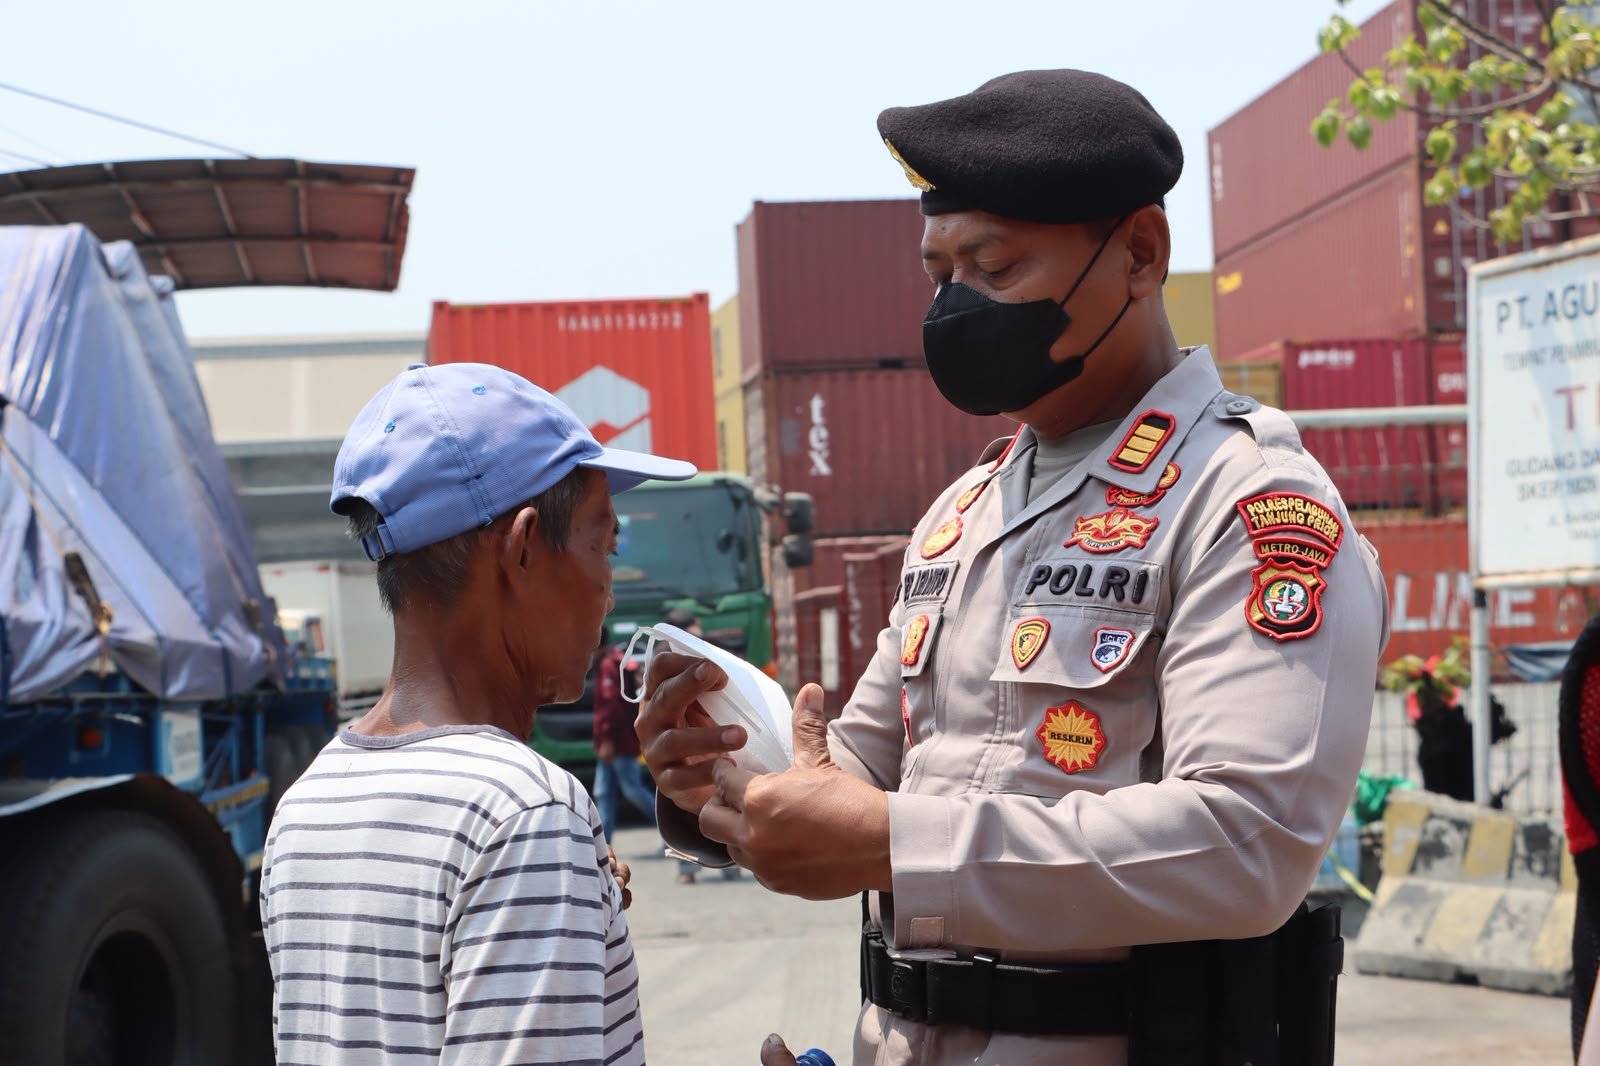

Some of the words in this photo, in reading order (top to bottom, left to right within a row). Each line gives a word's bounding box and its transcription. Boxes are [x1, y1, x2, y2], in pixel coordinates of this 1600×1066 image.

[1497, 296, 1534, 334] PT.
[808, 393, 832, 475] tex
[1251, 510, 1305, 529] TANJUNG
[1307, 516, 1338, 541] PRIOK
[1260, 543, 1300, 554] METRO
[1301, 547, 1326, 563] JAYA
[1025, 563, 1148, 604] POLRI
[1050, 731, 1093, 746] RESKRIM
